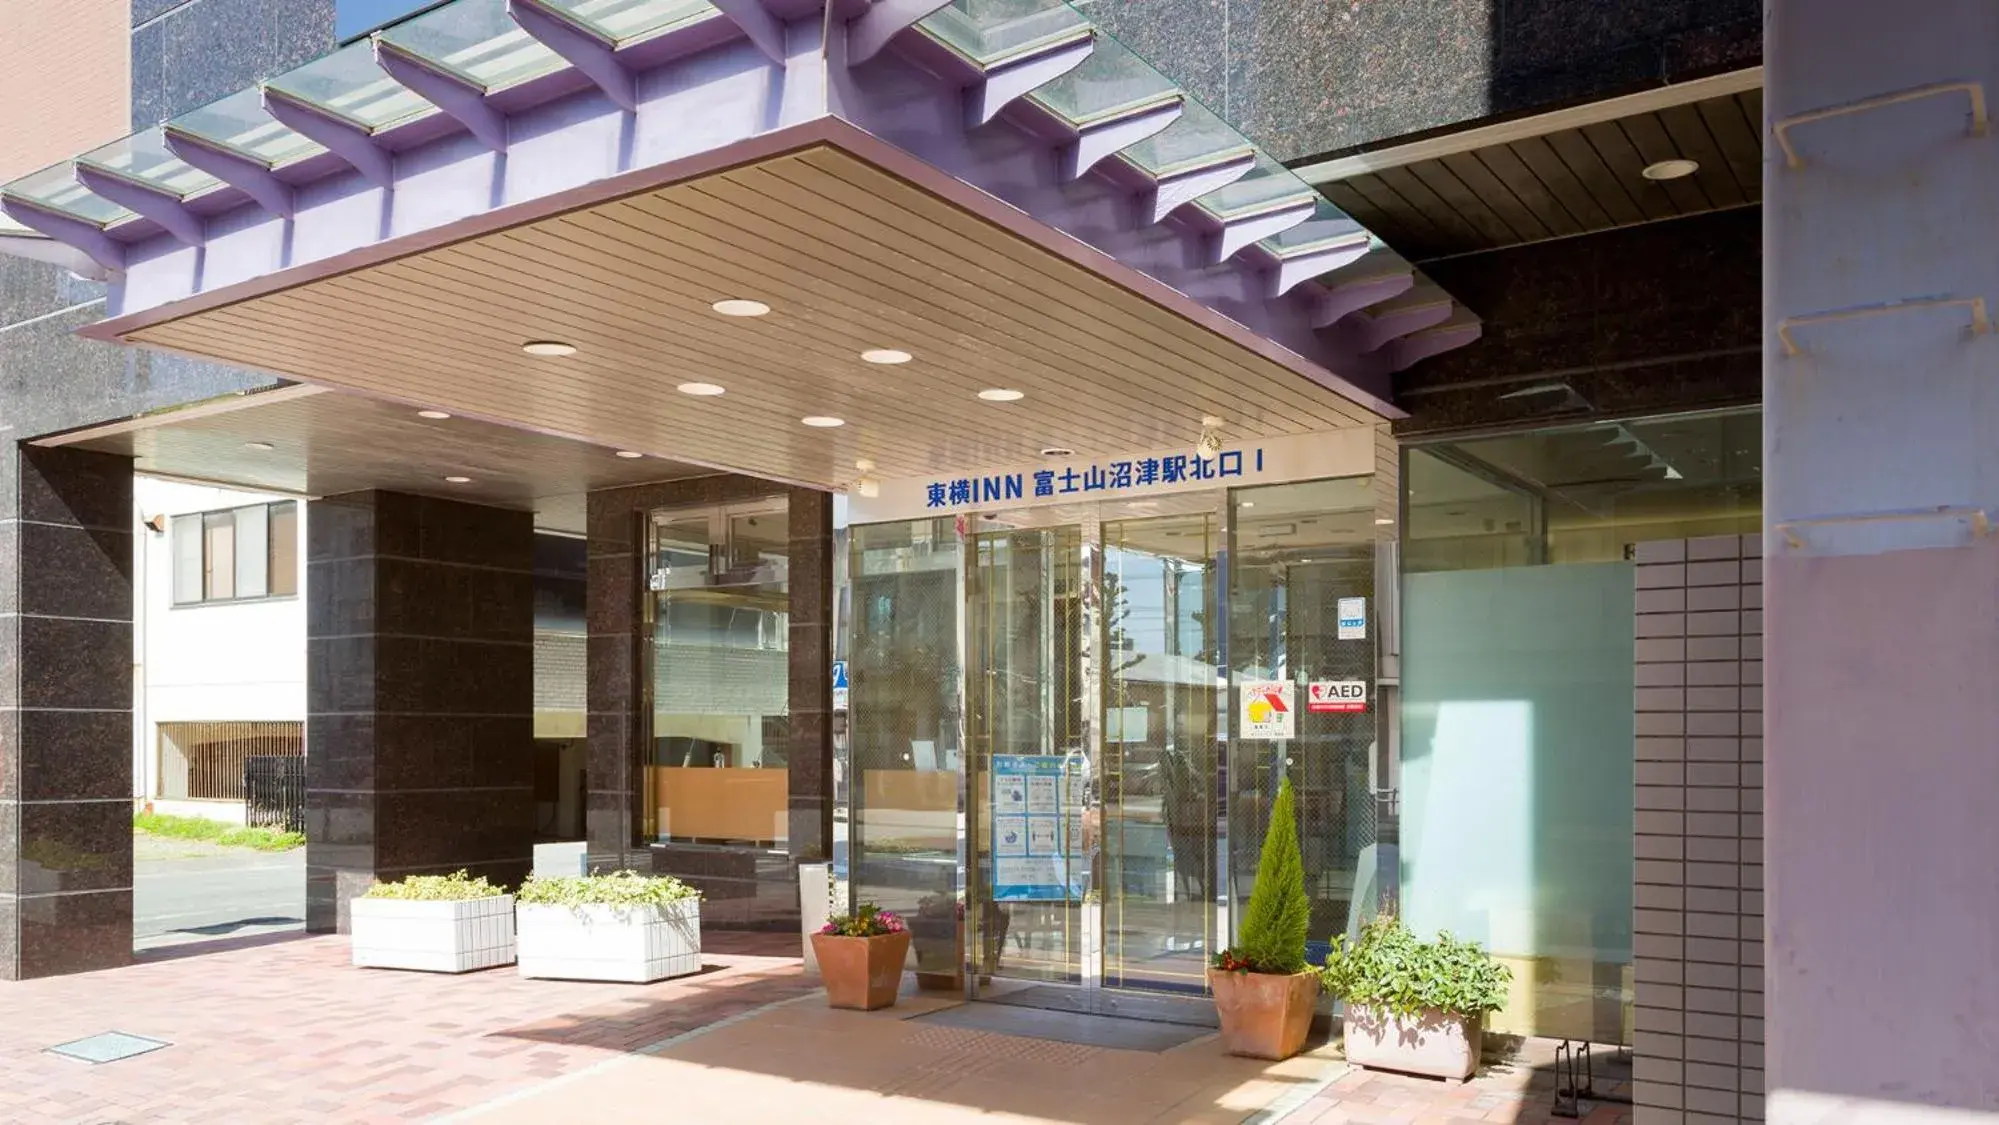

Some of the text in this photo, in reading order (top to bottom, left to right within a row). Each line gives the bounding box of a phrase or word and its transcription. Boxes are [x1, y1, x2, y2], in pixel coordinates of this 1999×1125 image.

[926, 474, 1023, 507] 東横INN
[1033, 450, 1242, 497] 富士山沼津駅北口
[1328, 685, 1363, 698] AED
